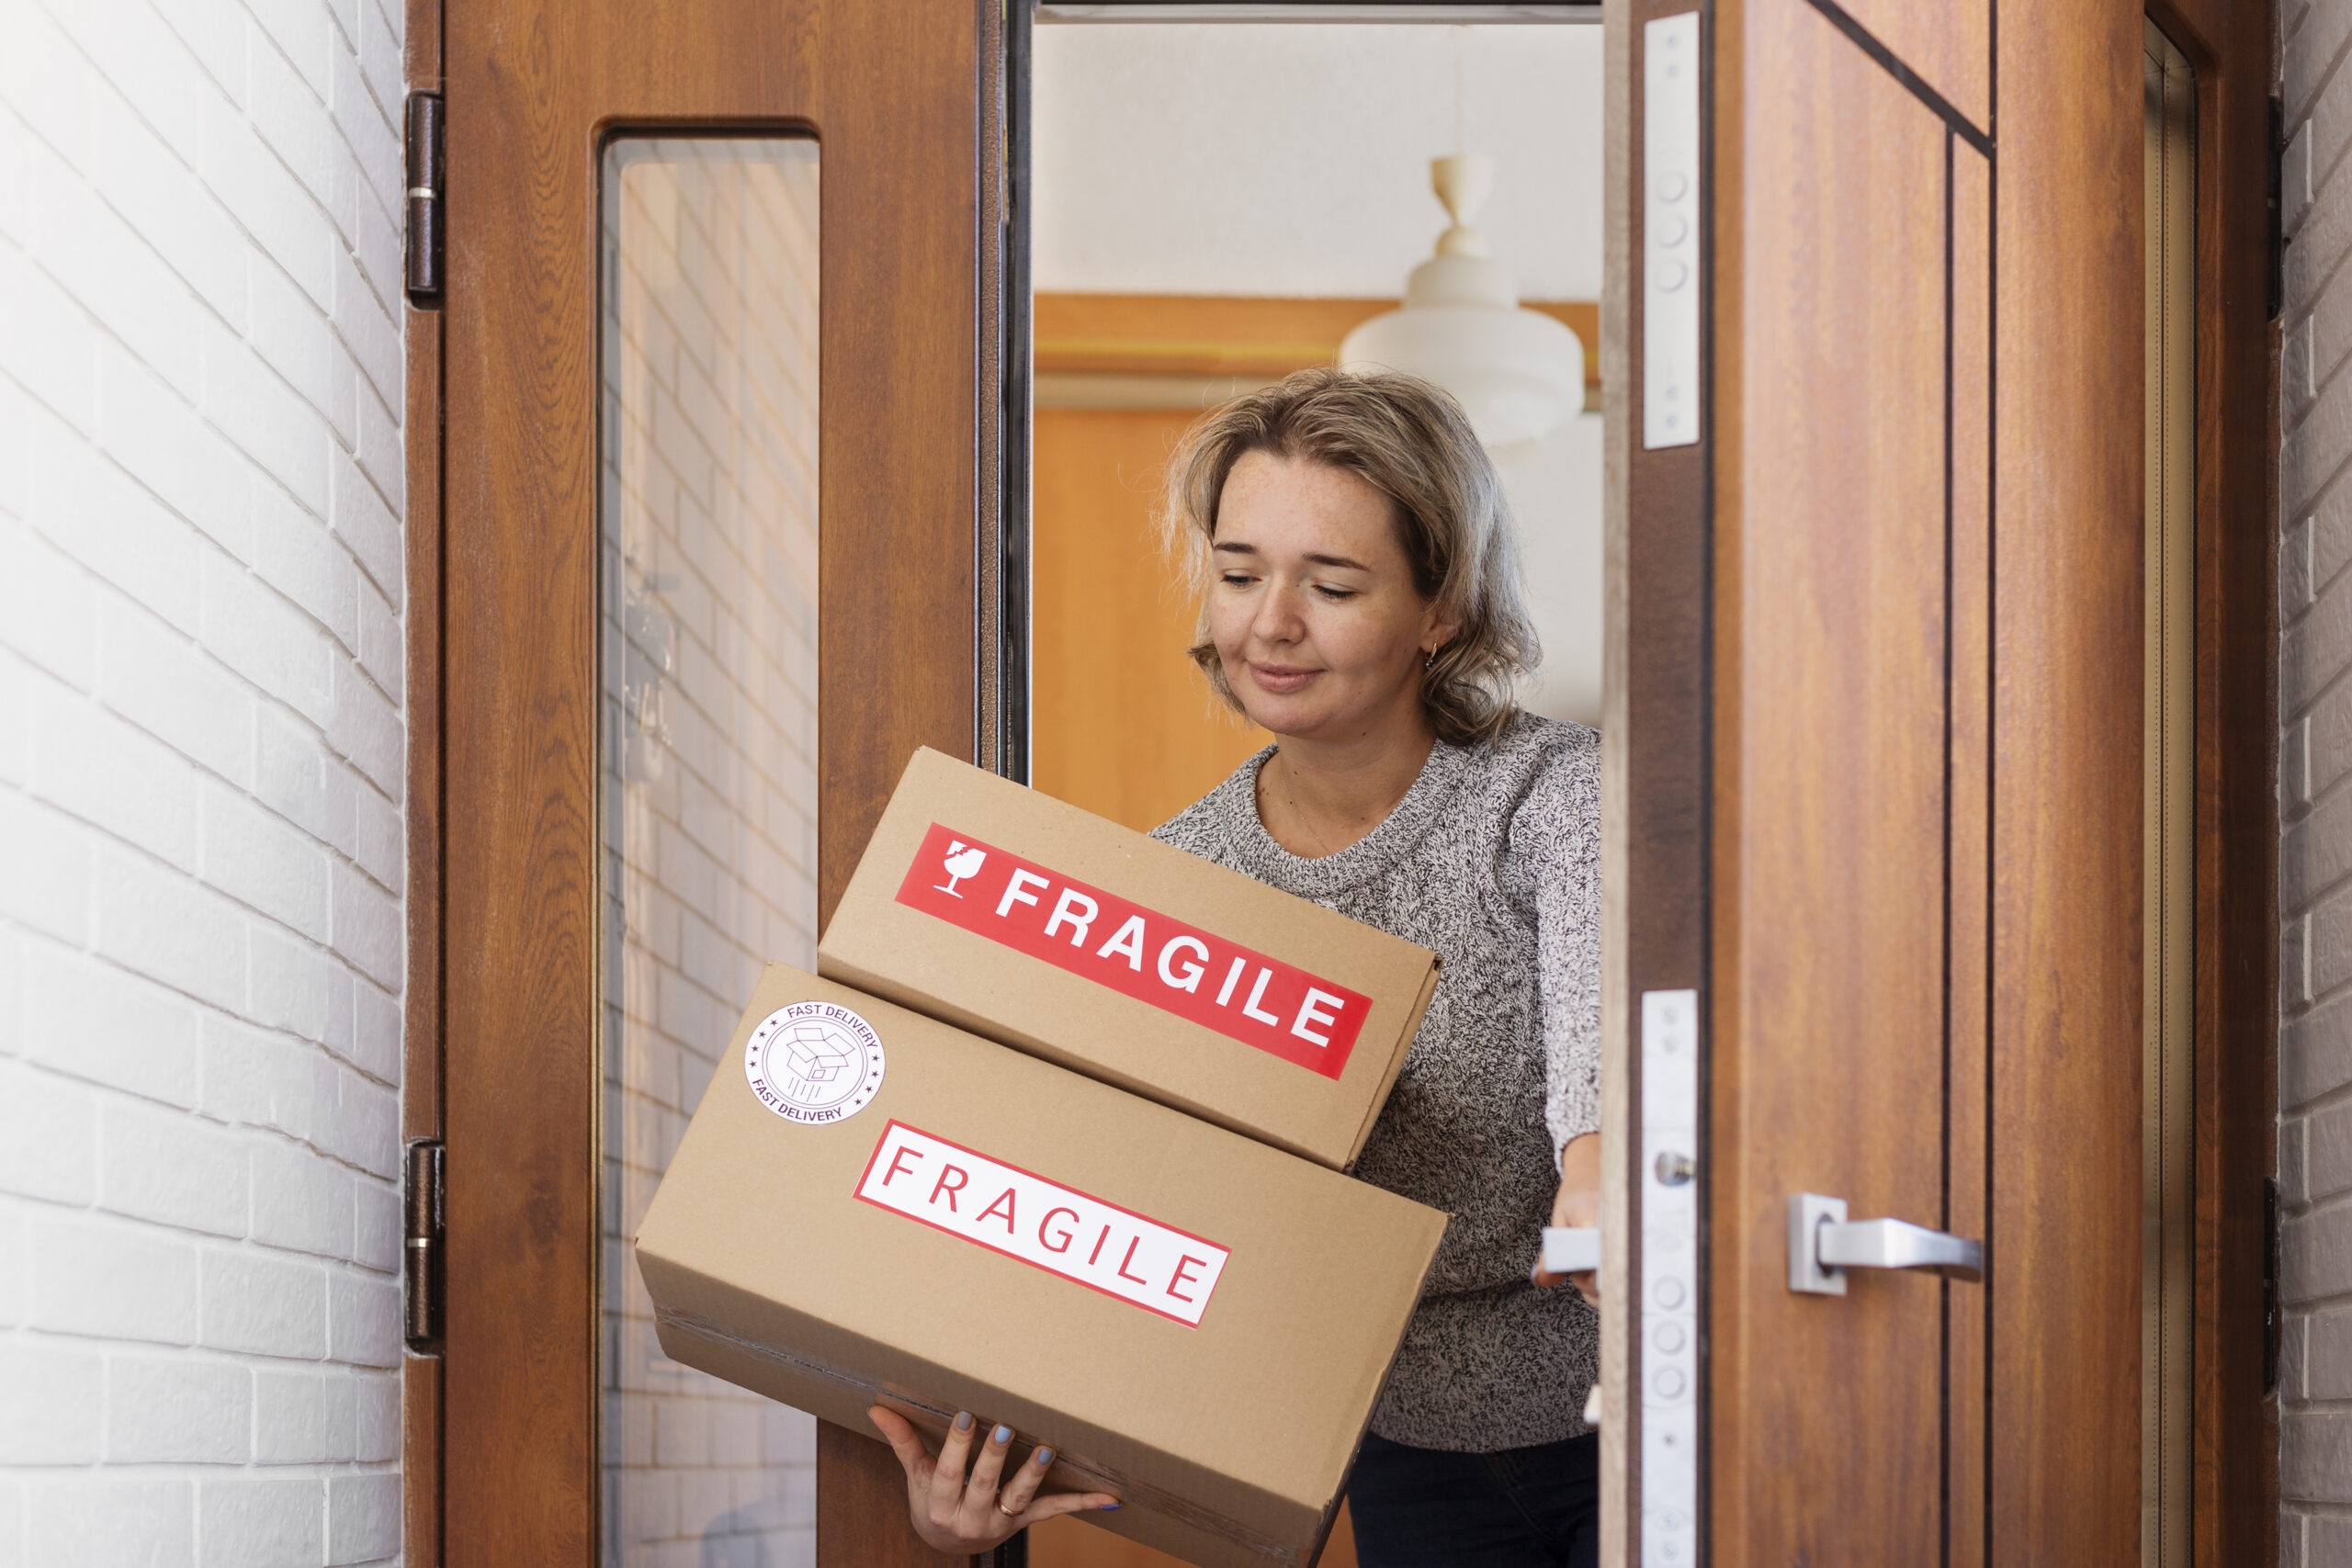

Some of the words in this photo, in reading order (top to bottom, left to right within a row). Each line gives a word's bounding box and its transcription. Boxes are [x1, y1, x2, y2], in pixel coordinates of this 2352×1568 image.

[995, 867, 1345, 1048] FRAGILE
[786, 1004, 822, 1019] FAST
[825, 1006, 878, 1048] DELIVERY
[752, 1078, 779, 1107] FAST
[777, 1103, 842, 1122] DELIVERY
[882, 1145, 1207, 1303] FRAGILE
